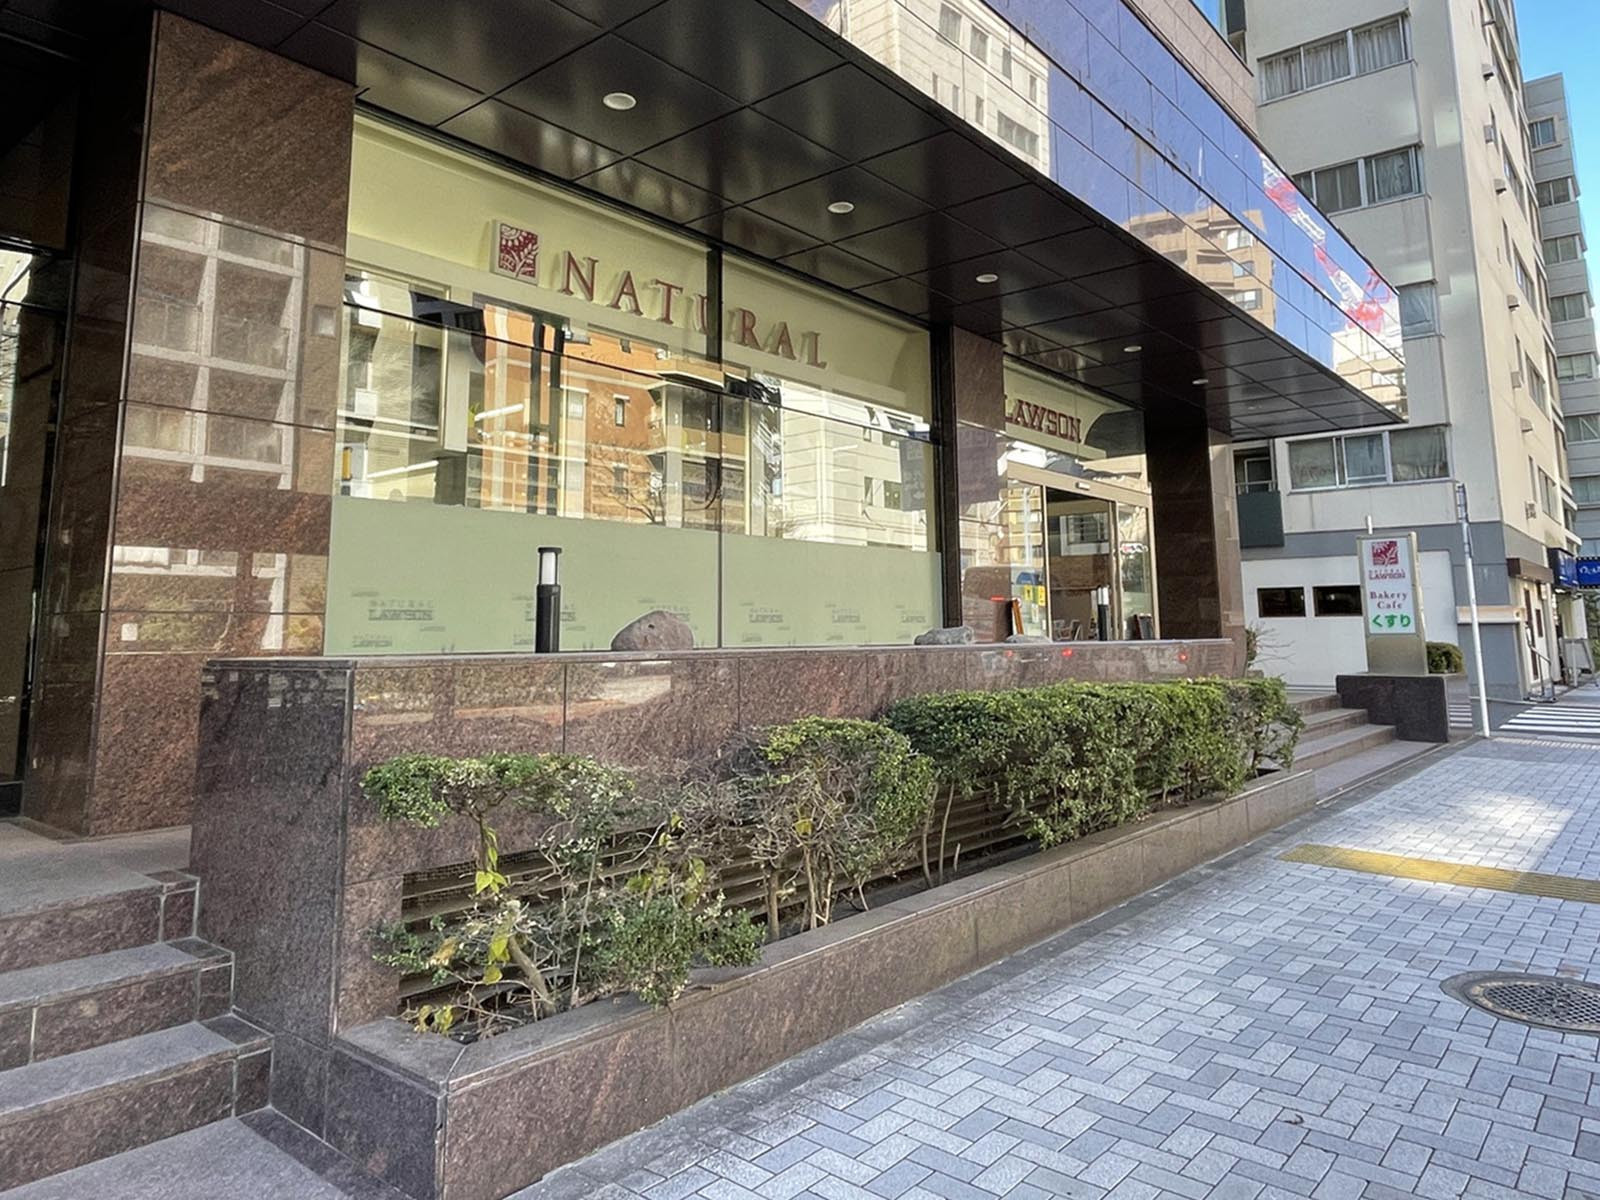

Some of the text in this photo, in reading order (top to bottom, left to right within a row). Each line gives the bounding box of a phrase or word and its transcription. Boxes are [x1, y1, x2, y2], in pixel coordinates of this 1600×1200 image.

[1370, 591, 1407, 601] Bakery
[1372, 614, 1412, 628] くすり
